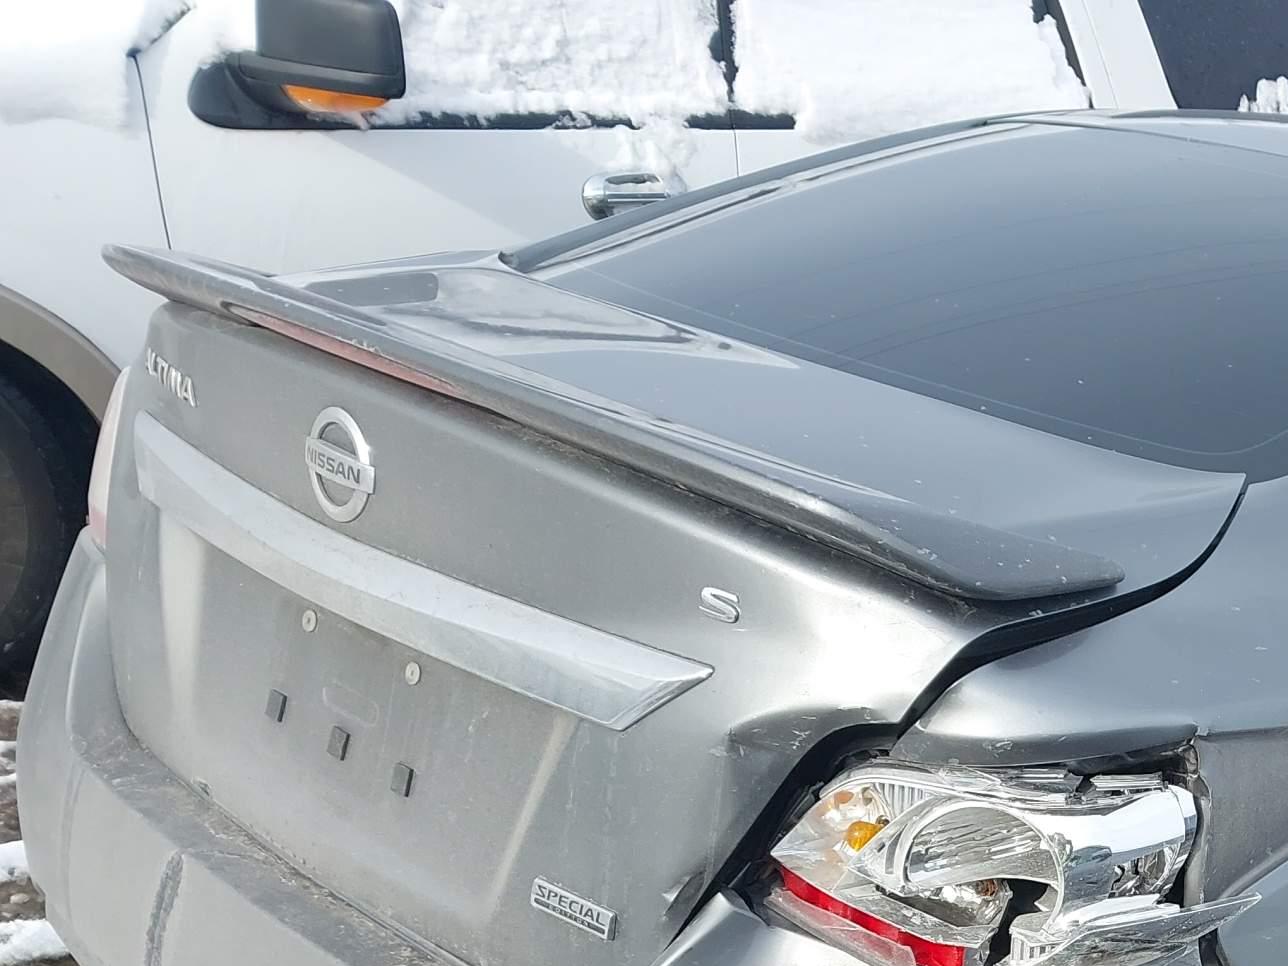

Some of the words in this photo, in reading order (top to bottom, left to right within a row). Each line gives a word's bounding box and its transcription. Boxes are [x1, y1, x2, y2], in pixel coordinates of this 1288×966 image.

[308, 446, 361, 484] NISSAN
[699, 586, 741, 624] S
[534, 884, 606, 928] SPECIAL
